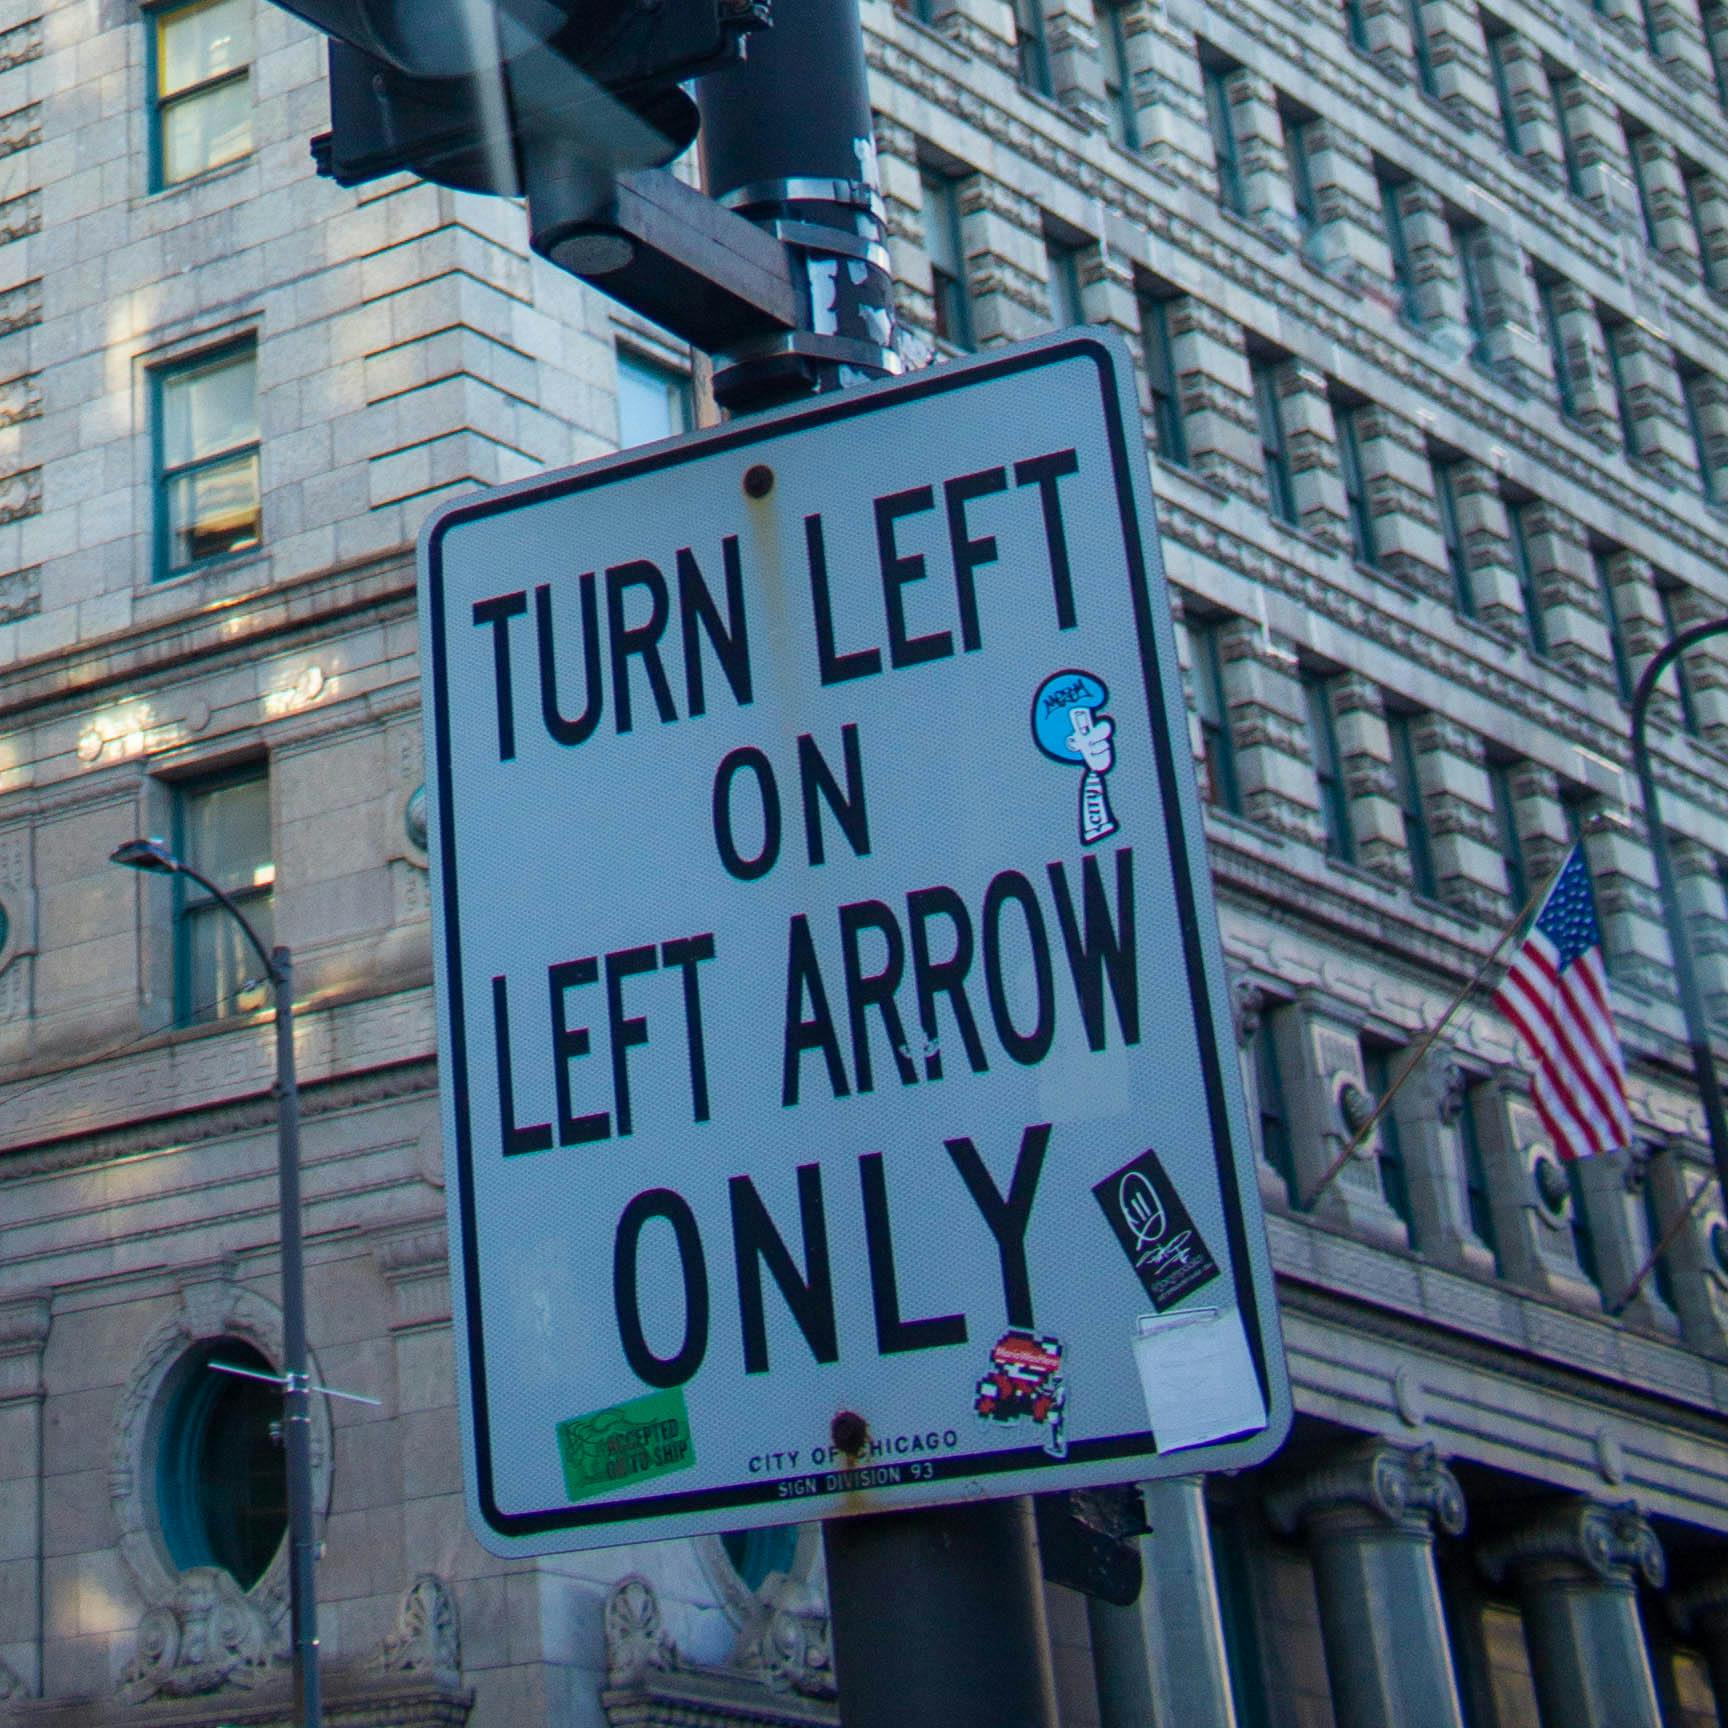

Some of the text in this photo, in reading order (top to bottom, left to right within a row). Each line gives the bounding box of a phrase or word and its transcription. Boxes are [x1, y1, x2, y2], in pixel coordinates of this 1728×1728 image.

[473, 449, 1079, 761] TURN LEFT
[713, 723, 871, 881] ON
[493, 848, 1141, 1157] LEFT ARROW
[613, 1123, 1052, 1390] ONLY
[654, 1440, 688, 1467] SHIP
[748, 1450, 800, 1473] CITY
[811, 1445, 840, 1466] OF
[778, 1462, 934, 1497] SIGN DIVISION 93
